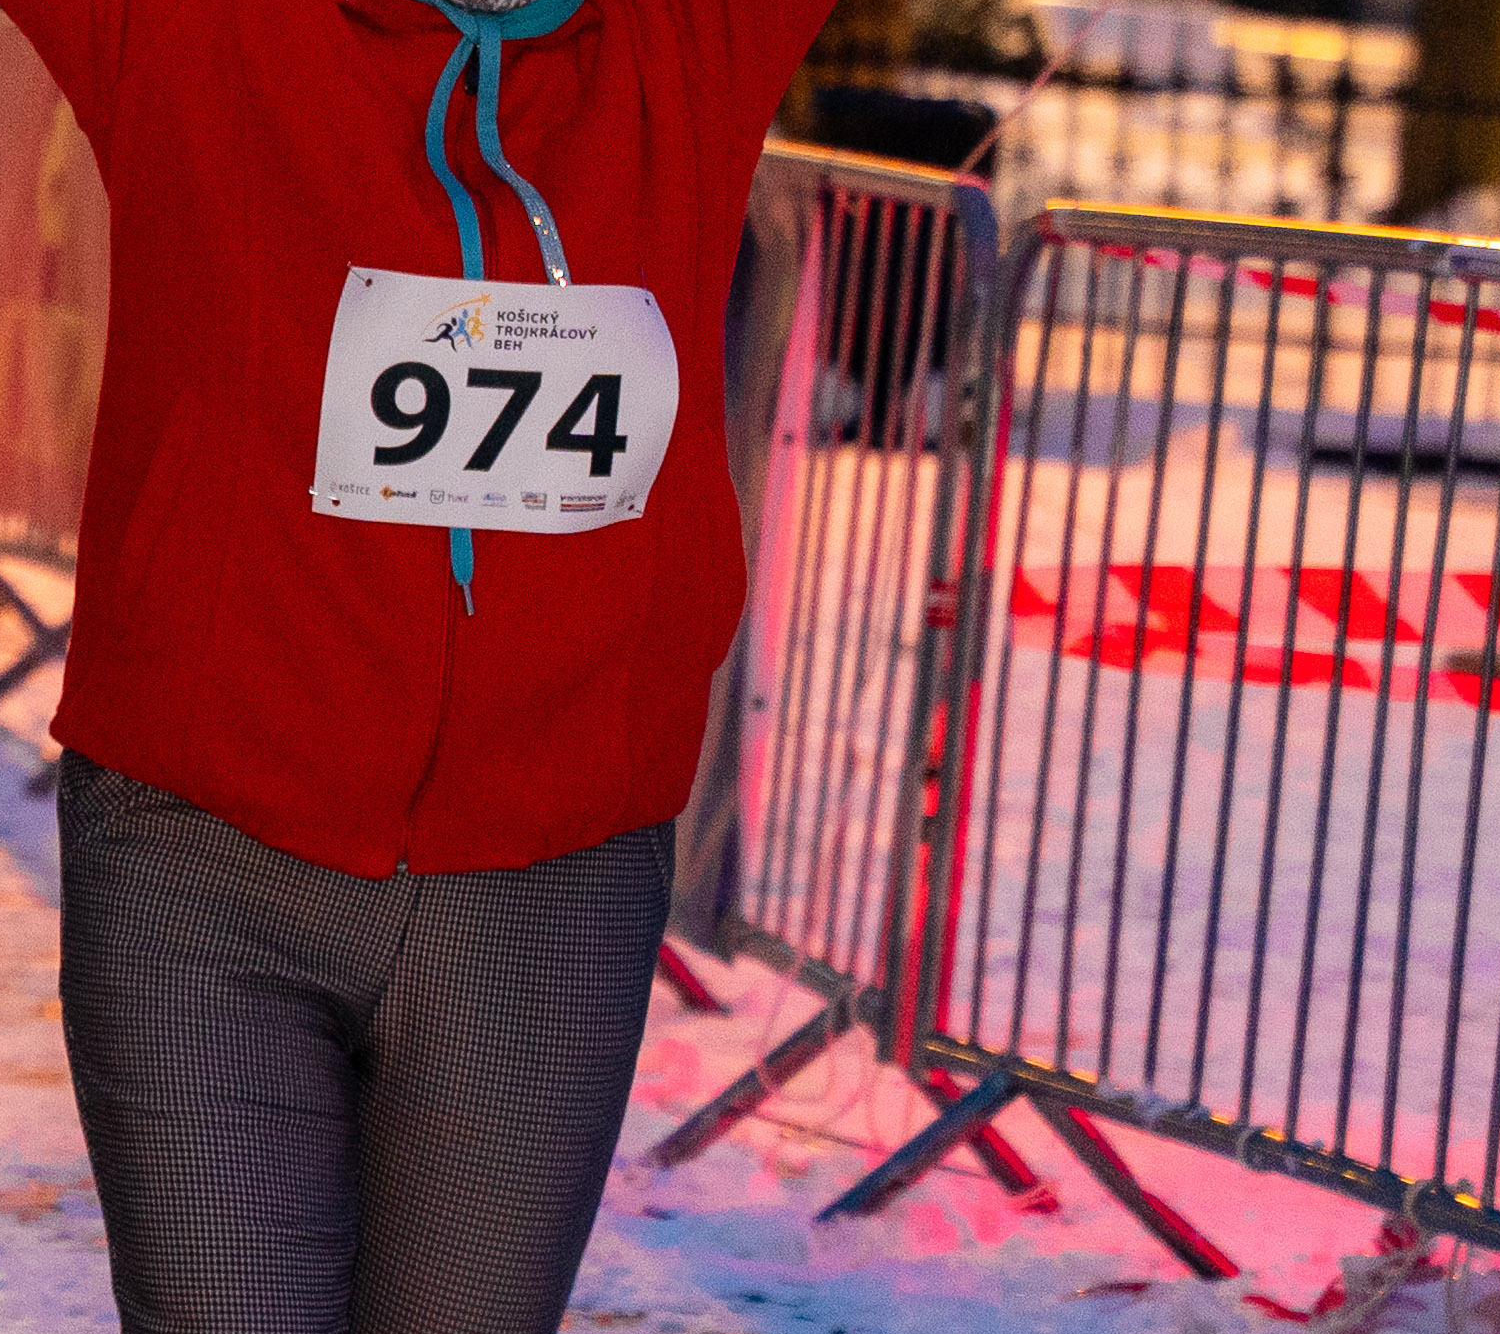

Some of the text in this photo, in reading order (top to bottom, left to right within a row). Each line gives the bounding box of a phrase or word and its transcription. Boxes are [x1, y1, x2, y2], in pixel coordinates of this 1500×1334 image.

[496, 309, 559, 324] KOŠICKÝ
[495, 325, 597, 340] TROJKRÁĽOVÝ
[493, 339, 522, 351] BEH
[370, 361, 629, 478] 974
